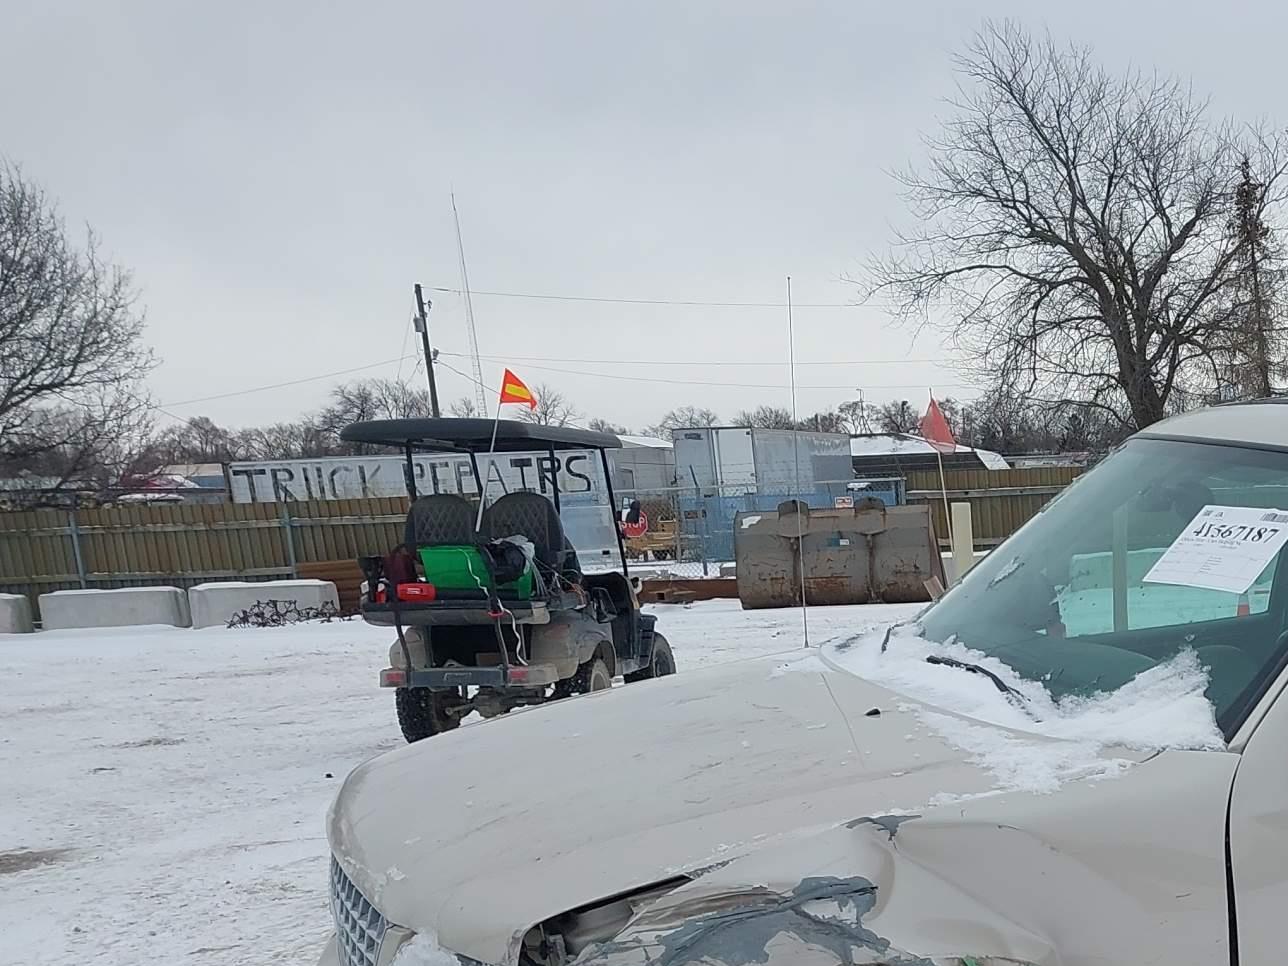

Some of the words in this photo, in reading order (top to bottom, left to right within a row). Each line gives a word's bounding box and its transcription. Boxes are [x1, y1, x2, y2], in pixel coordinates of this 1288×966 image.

[232, 463, 381, 504] TRUCK
[402, 455, 592, 497] REPAIRS
[1193, 521, 1280, 544] 41567187
